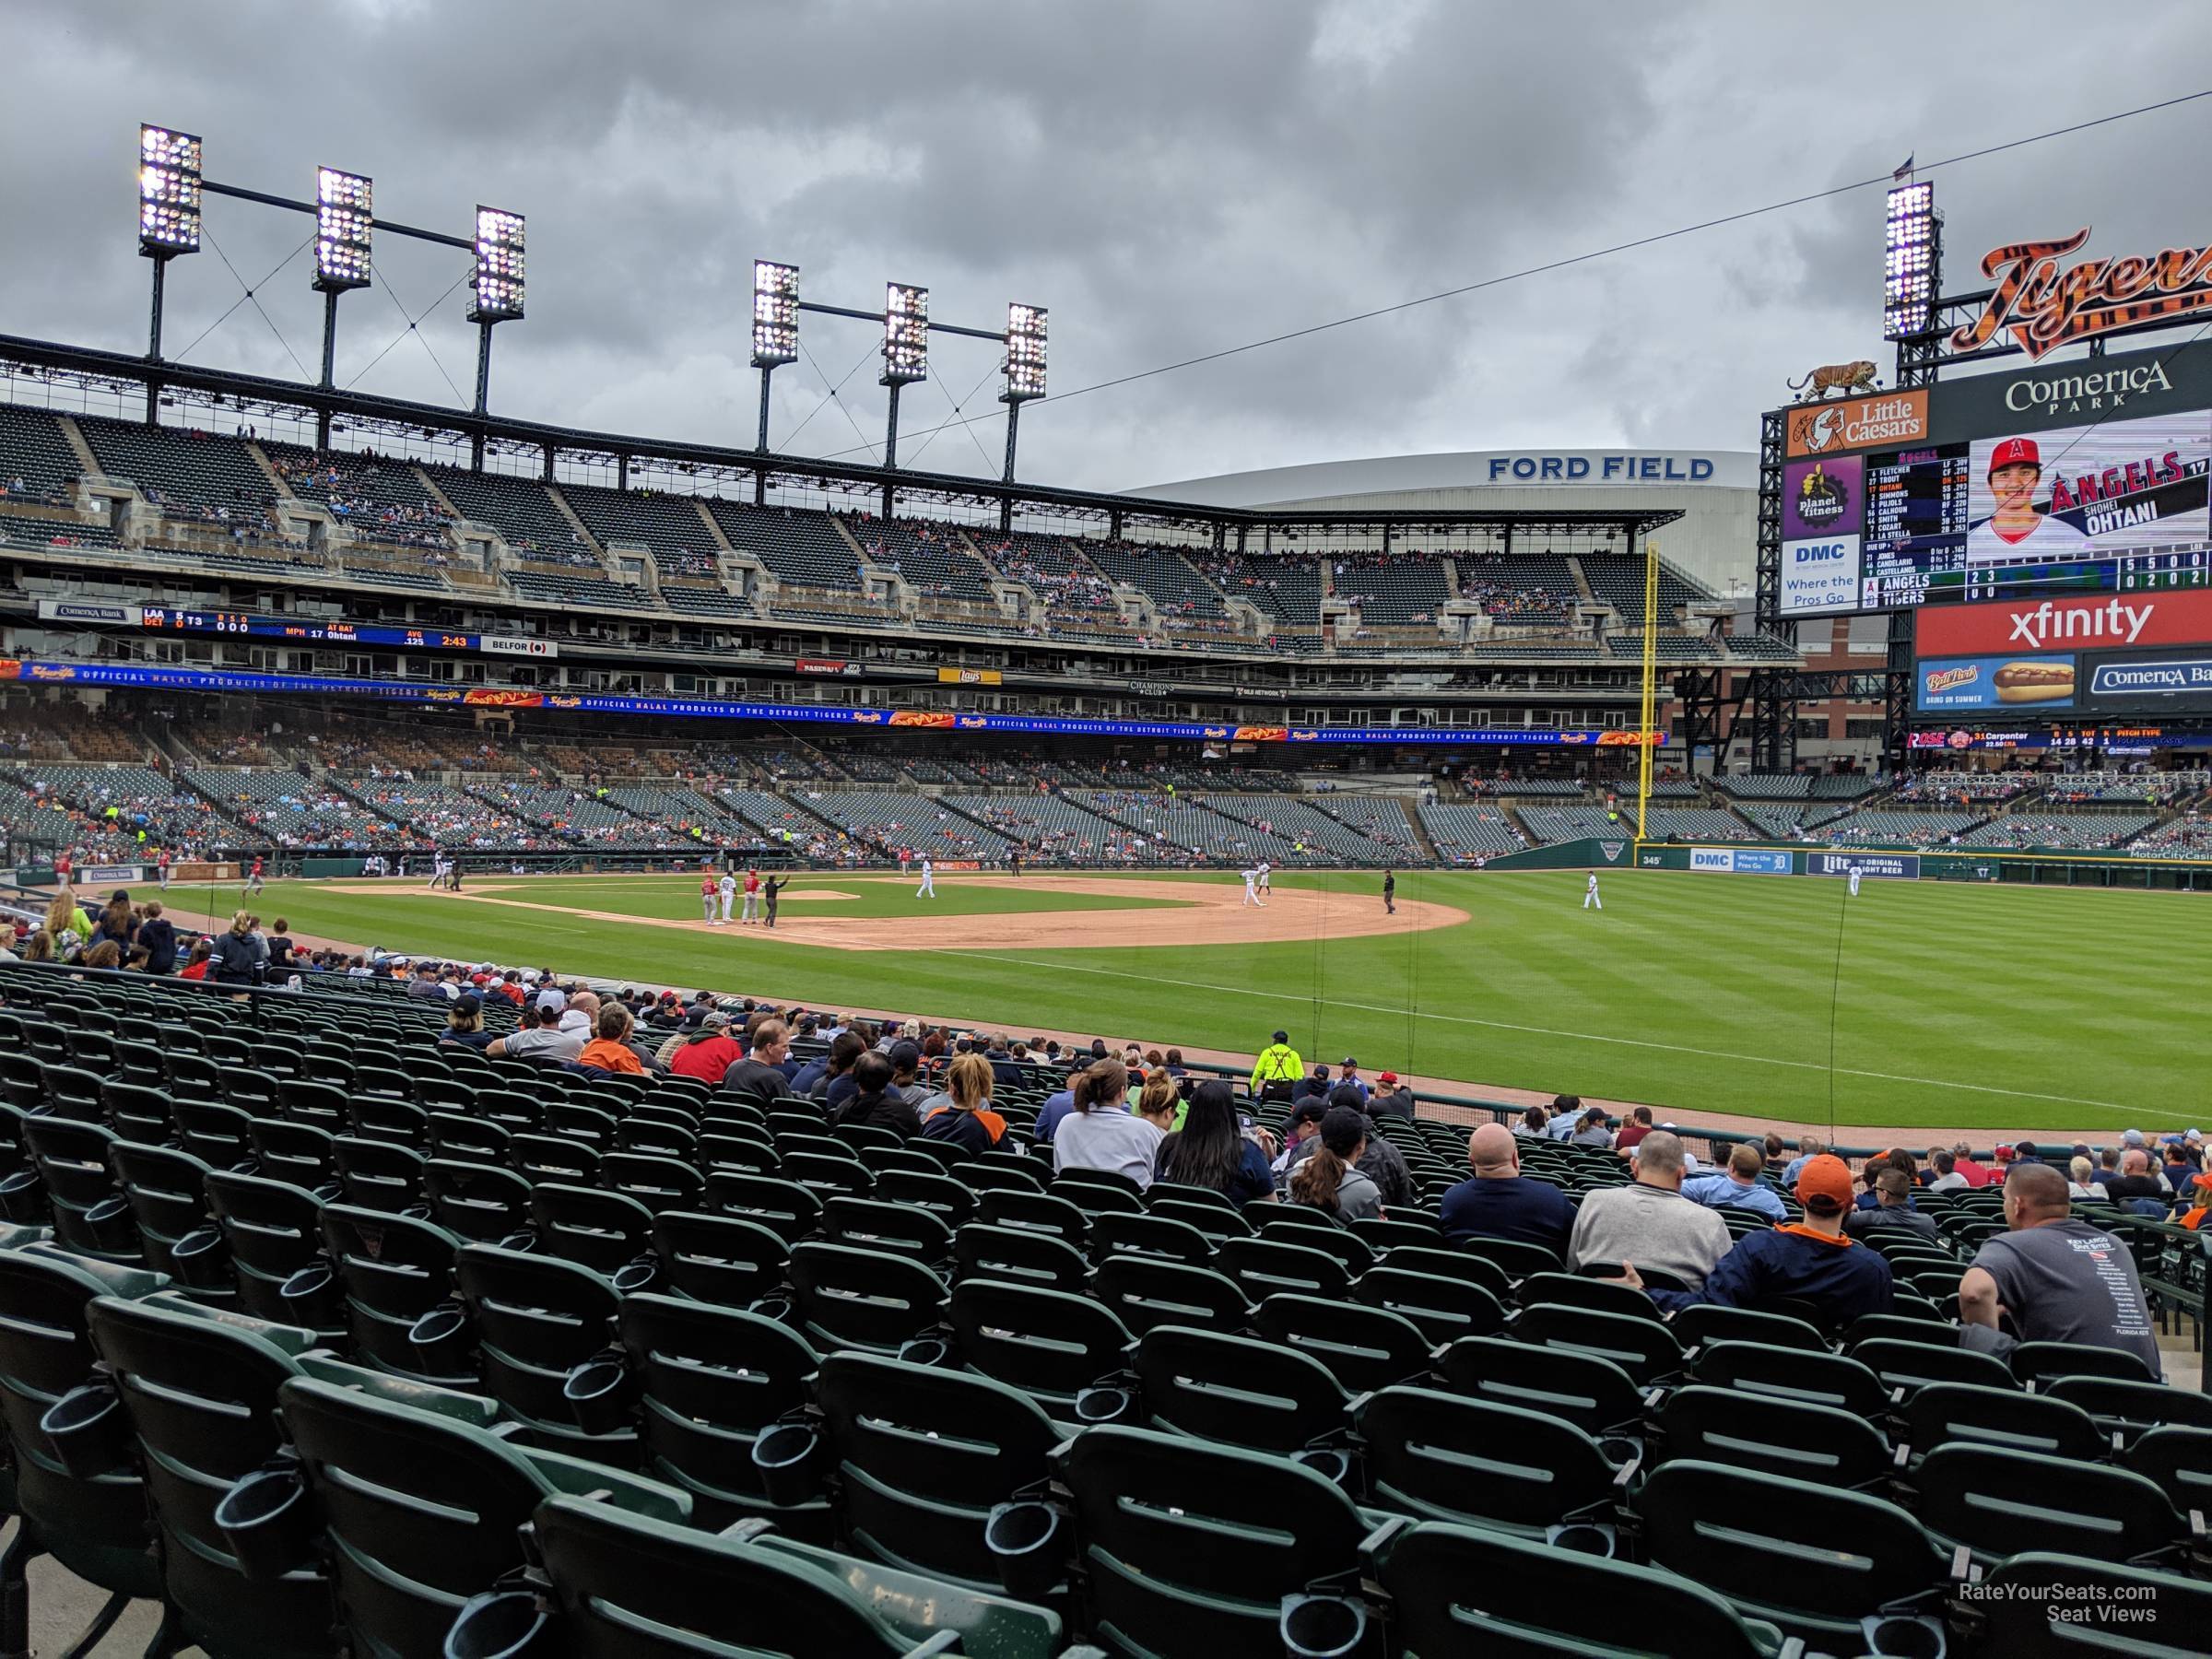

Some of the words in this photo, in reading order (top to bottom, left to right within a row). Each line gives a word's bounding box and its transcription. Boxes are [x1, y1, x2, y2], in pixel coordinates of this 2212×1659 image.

[1950, 225, 2212, 353] Tiger
[2049, 394, 2125, 415] PARK
[1861, 398, 1912, 425] Little
[1845, 418, 1920, 442] Caesars
[1488, 457, 1591, 481] FORD
[1602, 456, 1714, 481] FIELD
[1880, 466, 1910, 476] FLETCHER
[2189, 460, 2206, 475] 17
[1880, 476, 1900, 484] TROUT
[2050, 451, 2184, 514] ANGELS
[1879, 483, 1902, 492] OHTANI
[1879, 490, 1908, 500] SIMMONS
[1799, 496, 1836, 512] planet
[1878, 499, 1902, 508] PUJOLS
[2084, 500, 2118, 517] SHOHEI
[1804, 504, 1843, 517] fitness
[1878, 506, 1908, 516] CALHOUN
[1878, 515, 1899, 524] SMITH
[2087, 500, 2159, 535] OHTANI
[1878, 523, 1902, 532] COZART
[1888, 530, 1911, 538] STELLA
[1795, 543, 1845, 562] DMC
[1877, 552, 1895, 560] JONES
[1877, 559, 1913, 568] CANDELARIO
[1877, 566, 1915, 576] CASTELLANOS
[1884, 575, 1930, 590] ANGELS
[1972, 571, 1978, 582] 2
[1988, 571, 1994, 582] 3
[2127, 559, 2135, 571] 5
[2147, 557, 2155, 570] 5
[2171, 555, 2177, 568] 0
[2192, 554, 2199, 566] 0
[1786, 579, 1828, 590] Where
[1830, 576, 1853, 586] the
[1883, 591, 1924, 606] TIGERS
[1972, 588, 1978, 599] 0
[1987, 586, 1994, 597] 0
[2127, 575, 2134, 588] 0
[2147, 573, 2155, 586] 2
[2171, 572, 2177, 584] 0
[2192, 571, 2199, 582] 2
[1794, 595, 1821, 606] Pros
[1826, 593, 1844, 604] Go
[101, 608, 123, 618] Bank
[144, 608, 164, 618] LAA
[144, 618, 163, 627] DET
[175, 619, 184, 628] 0
[218, 622, 225, 630] 0
[229, 623, 236, 632] 0
[240, 623, 248, 632] 0
[327, 623, 337, 631] AT
[2008, 597, 2155, 648] xfinity
[286, 627, 306, 636] MPH
[328, 632, 357, 641] Ohtani
[442, 636, 466, 647] 2:43
[492, 641, 527, 651] BELFOR
[153, 675, 193, 684] HALAL
[1927, 673, 1951, 689] Ball
[1951, 666, 1976, 683] Park
[2191, 667, 2212, 682] Ba
[1130, 680, 1174, 691] CHAMPIONS
[586, 699, 630, 709] OFFICIAL
[673, 704, 724, 713] PRODUCTS
[769, 709, 809, 717] DETROIT
[1062, 723, 1102, 731] PRODUCTS
[1906, 732, 1946, 748] ROSE
[1985, 733, 2028, 741] Carpenter
[2051, 737, 2062, 746] 14
[2065, 737, 2076, 746] 28
[1694, 853, 1729, 866] DMC
[2131, 850, 2212, 861] MotorCityCasi
[1822, 855, 1851, 873] Lite
[1865, 859, 1902, 867] ORIGINAL
[2084, 1237, 2109, 1245] LARGO
